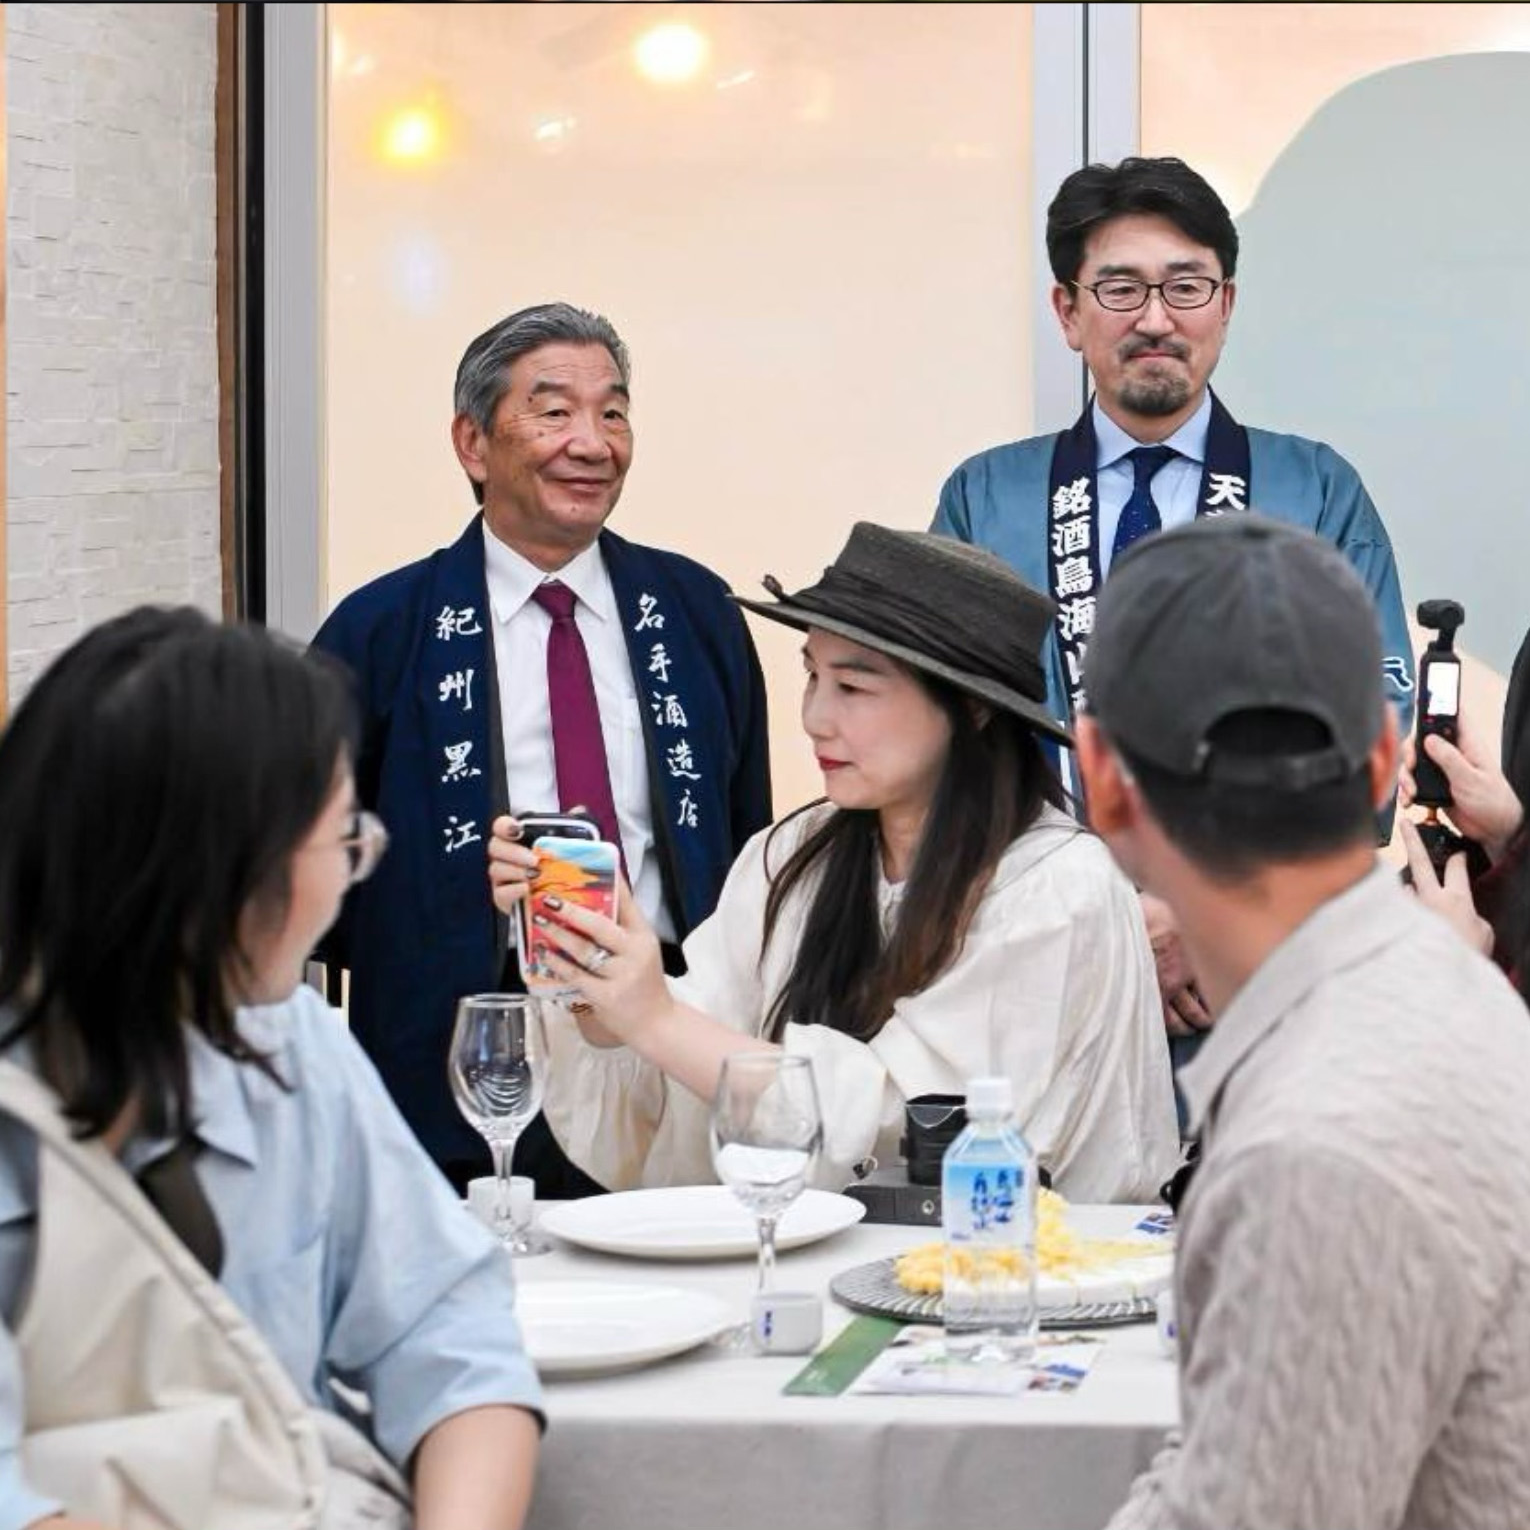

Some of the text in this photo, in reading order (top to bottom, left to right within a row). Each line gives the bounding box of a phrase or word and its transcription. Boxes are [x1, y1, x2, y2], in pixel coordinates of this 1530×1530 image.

[434, 604, 484, 854] 紀州黒江
[633, 592, 702, 829] 名手酒造店
